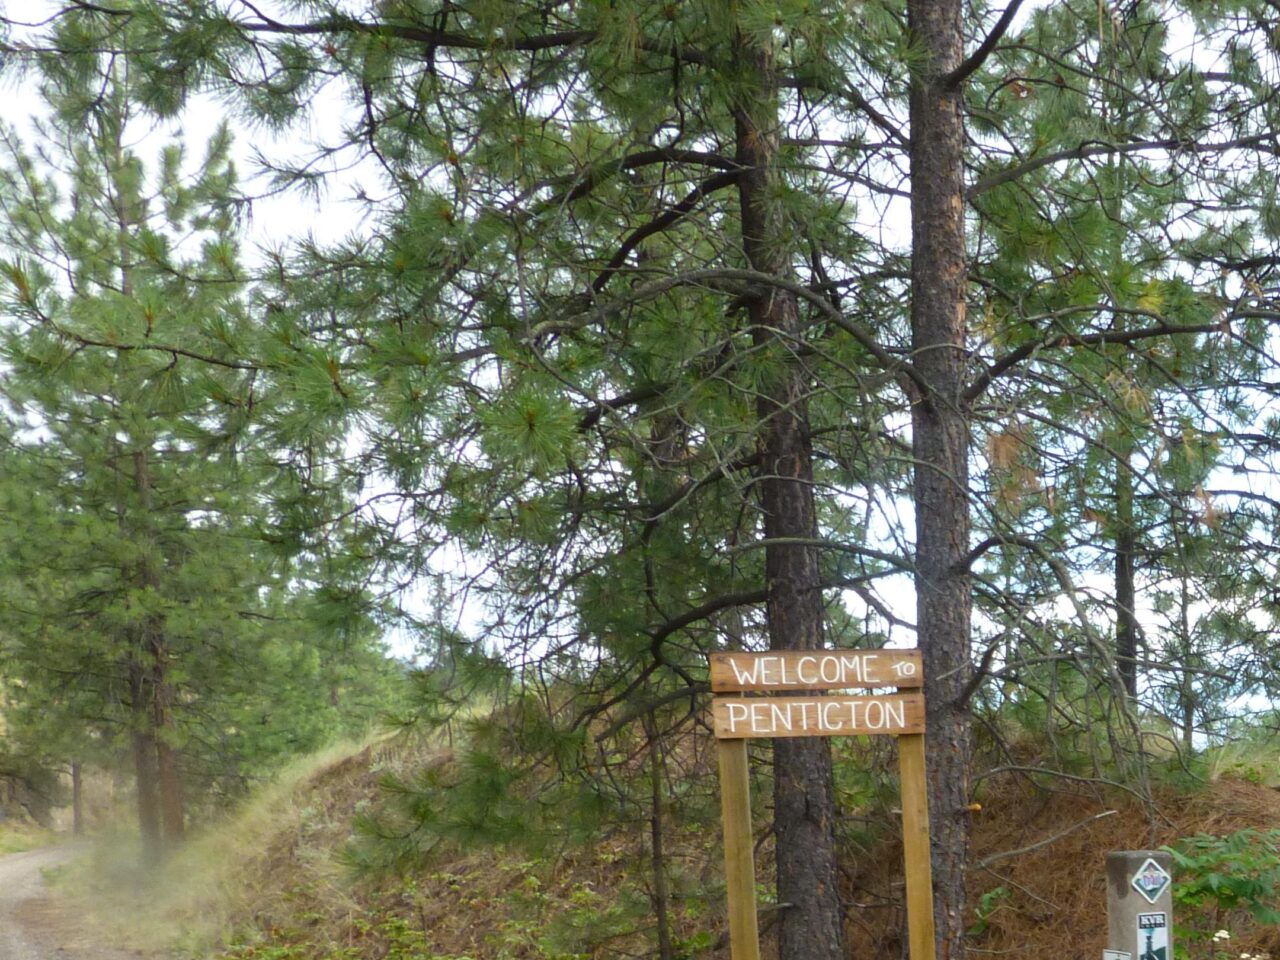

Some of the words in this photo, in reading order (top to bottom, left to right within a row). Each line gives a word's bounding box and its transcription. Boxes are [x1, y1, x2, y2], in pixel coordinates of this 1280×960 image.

[729, 654, 881, 686] WELCOME
[726, 700, 906, 733] PENTICTON
[1140, 915, 1164, 925] KVR
